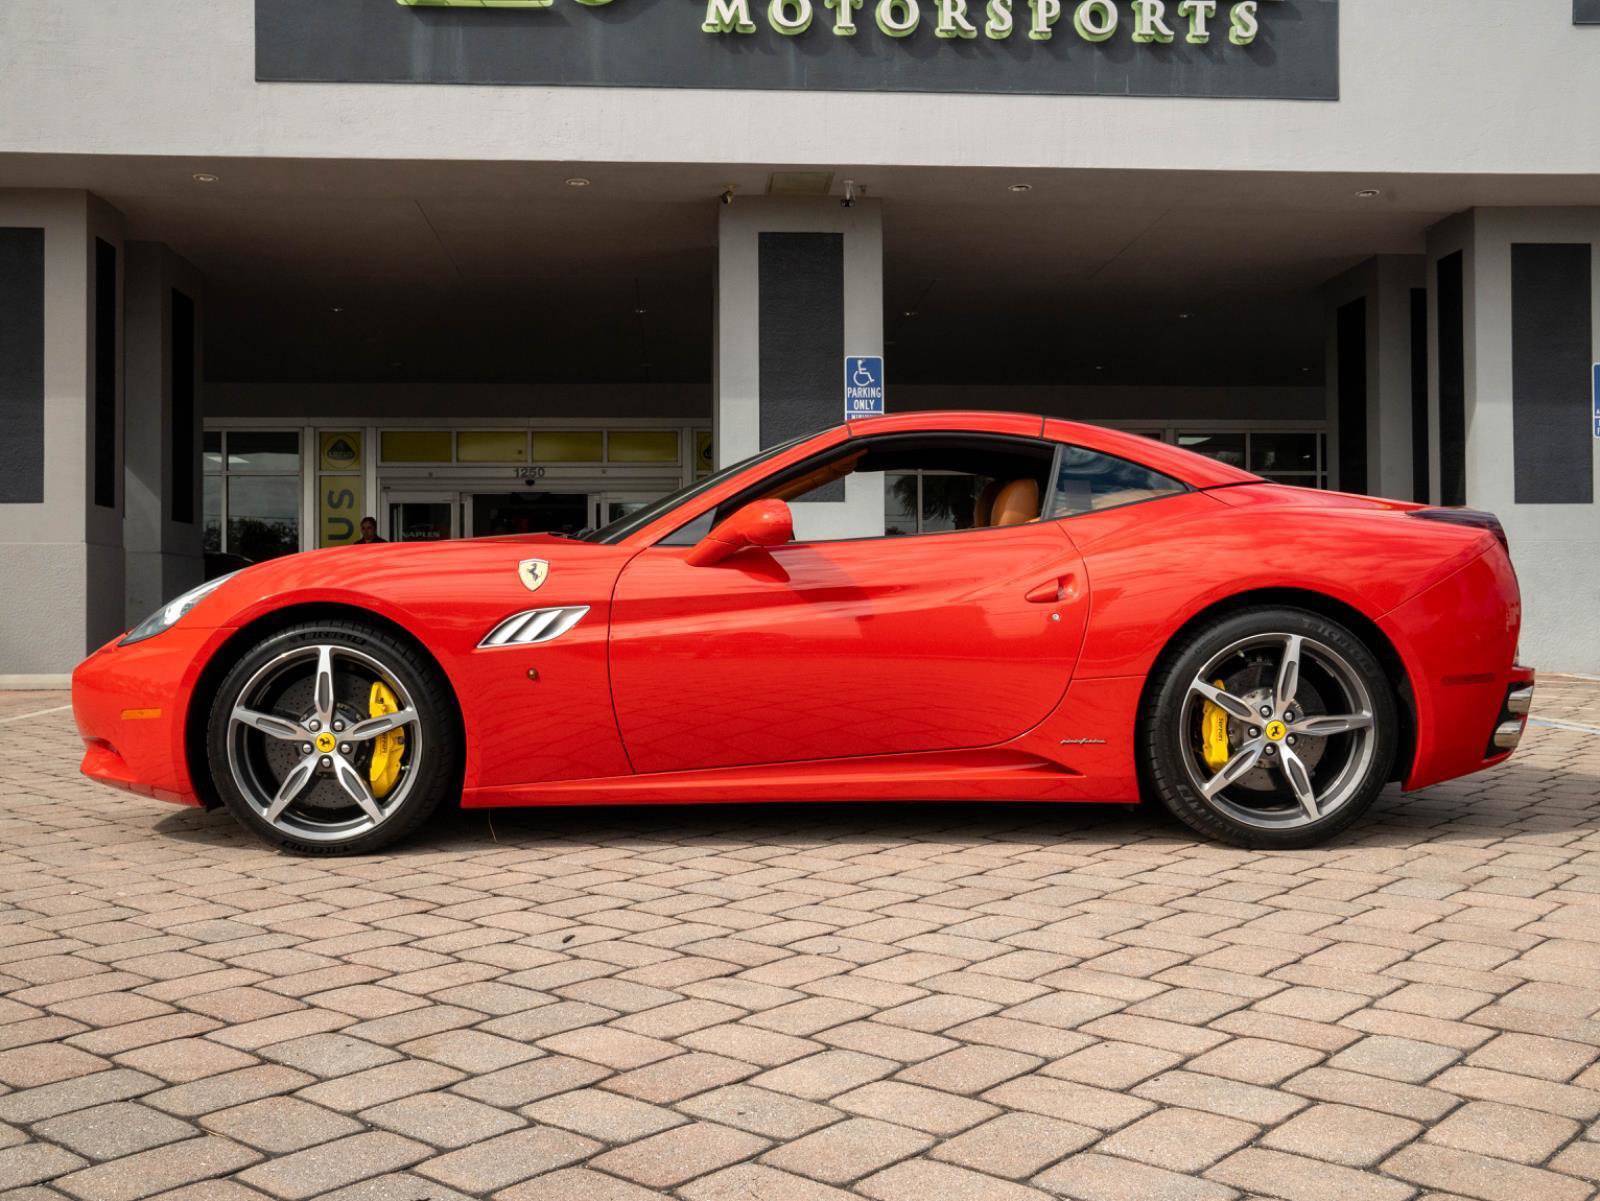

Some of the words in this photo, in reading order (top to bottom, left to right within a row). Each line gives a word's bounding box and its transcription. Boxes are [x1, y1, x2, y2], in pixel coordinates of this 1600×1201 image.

[702, 0, 1260, 45] MOTORSPORTS
[847, 387, 882, 398] PARKING
[853, 399, 875, 410] ONLY
[514, 467, 545, 478] 1250
